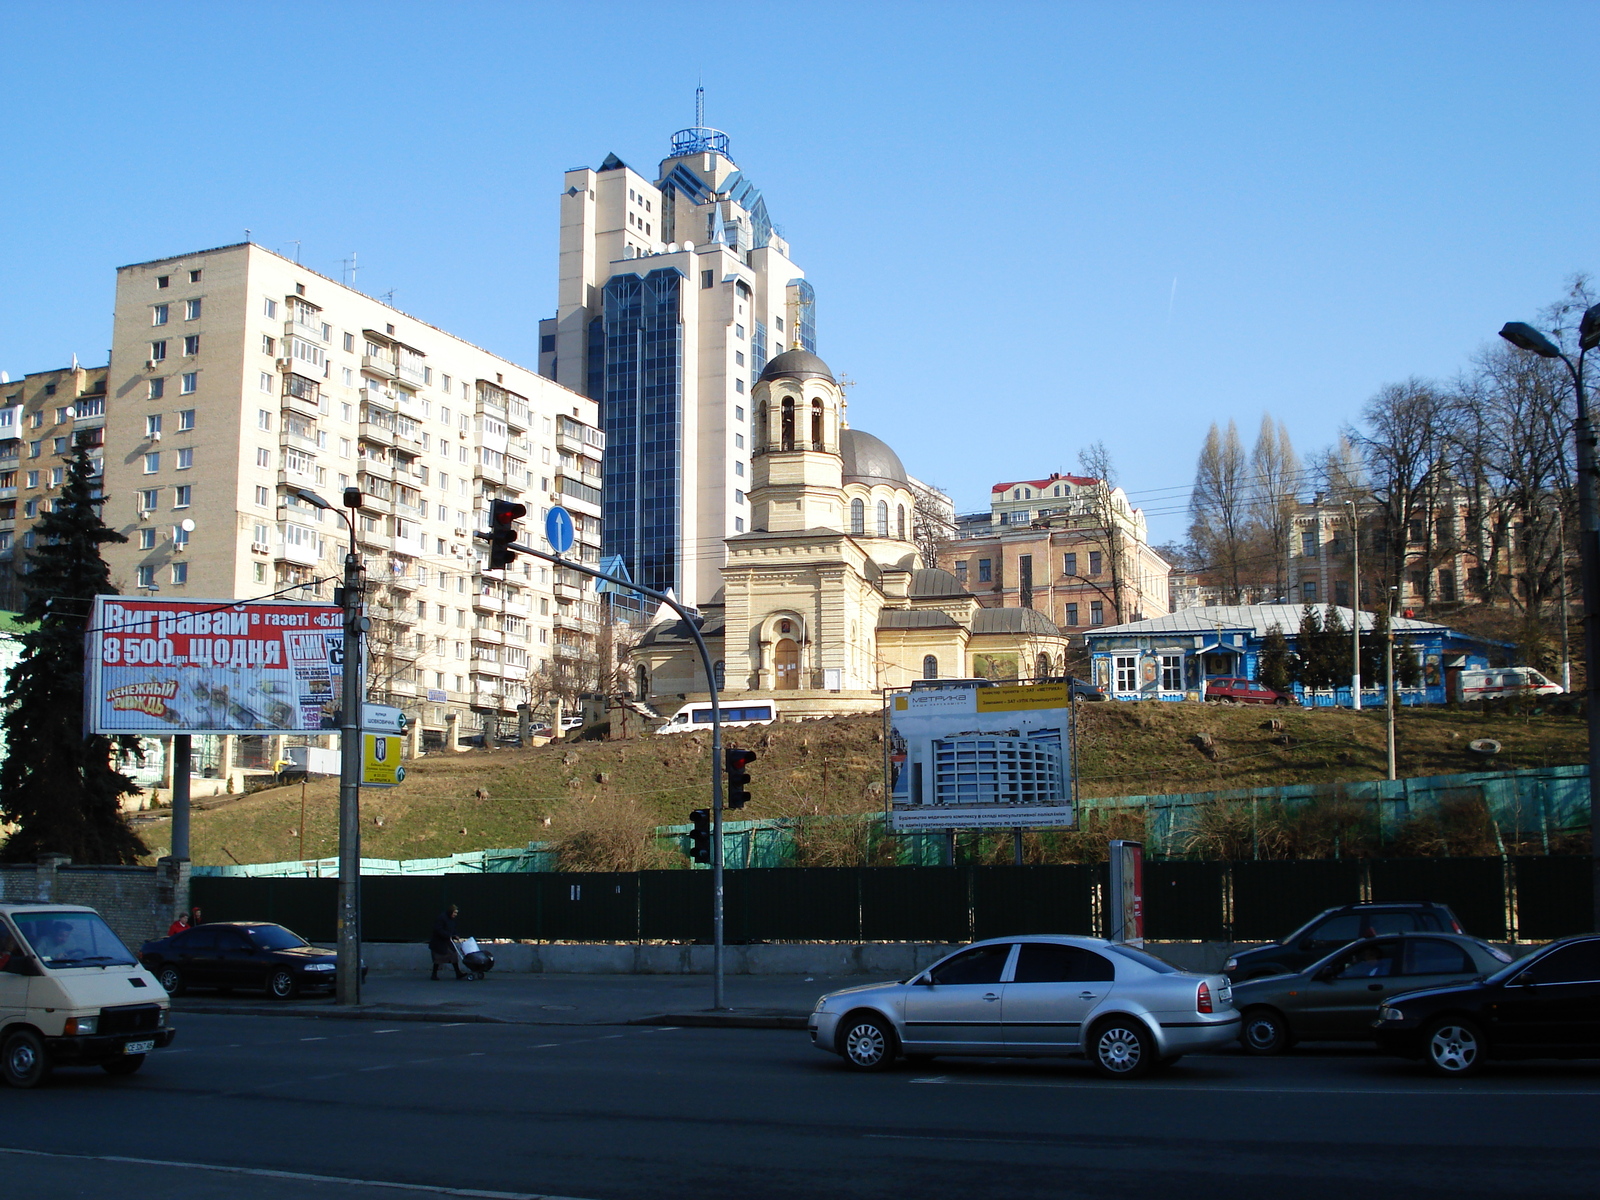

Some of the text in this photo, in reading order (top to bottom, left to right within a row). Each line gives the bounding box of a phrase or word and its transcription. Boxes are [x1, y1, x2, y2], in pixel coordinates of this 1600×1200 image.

[104, 604, 249, 639] Вигравай
[251, 613, 260, 625] в
[264, 612, 309, 627] газеті
[189, 638, 281, 669] ЩОДНЯ
